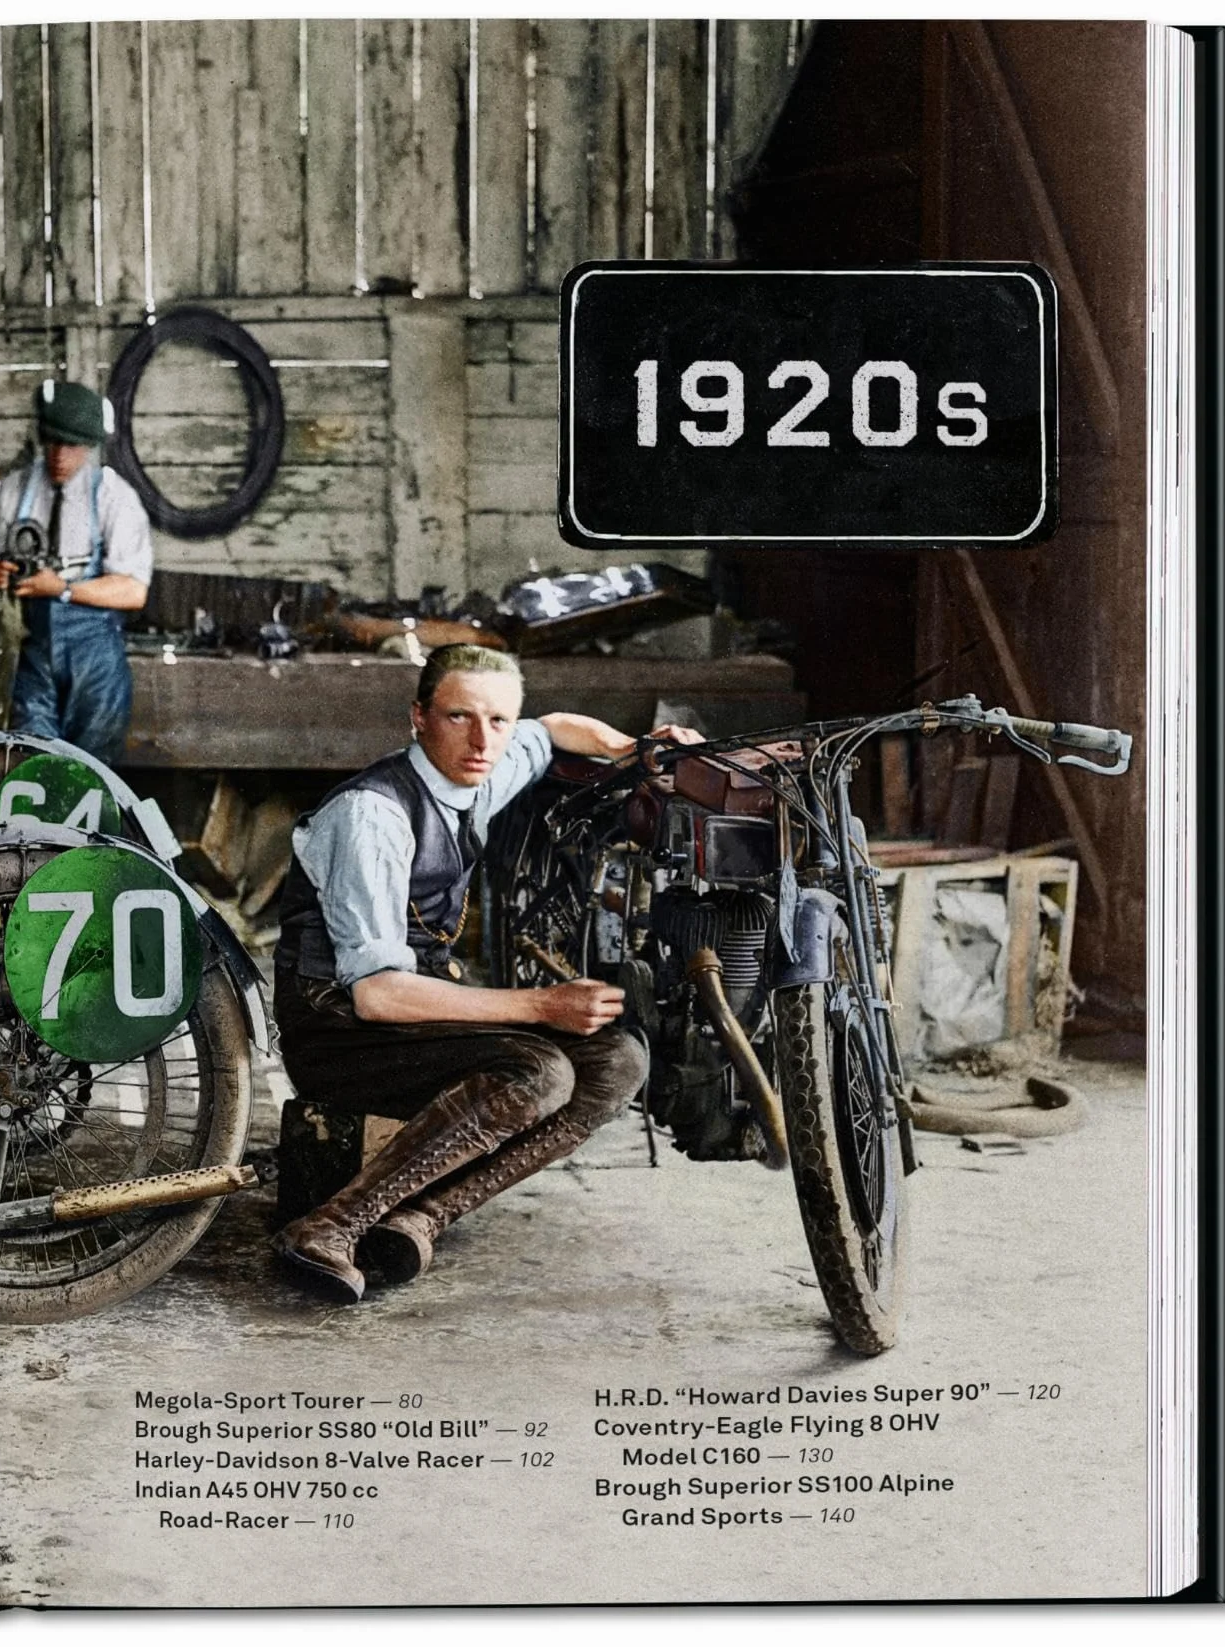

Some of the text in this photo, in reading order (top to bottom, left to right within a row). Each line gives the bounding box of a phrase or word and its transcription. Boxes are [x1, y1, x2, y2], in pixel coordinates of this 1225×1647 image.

[633, 359, 988, 447] 1920s
[27, 889, 183, 1020] 70
[135, 1391, 423, 1415] Megola-Sport Tourer 80
[595, 1387, 669, 1407] H.R.D.
[787, 1385, 868, 1404] Davies
[873, 1384, 945, 1407] Super
[1028, 1384, 1061, 1400] 120
[135, 1420, 211, 1444] Brough
[216, 1421, 314, 1444] Superior
[318, 1421, 377, 1439] SS80
[524, 1422, 548, 1438] 92
[594, 1413, 940, 1440] Coventry-Eagle Flying 8 OHV
[135, 1450, 555, 1474] Harley-Davidson 8-Valve Racer 102
[622, 1447, 834, 1466] Model C160 130
[135, 1480, 379, 1499] Indian A45 OHV 750 cc
[595, 1473, 955, 1501] Brough Superior SS100 Alpine
[159, 1510, 355, 1529] Road-Racer 110
[622, 1507, 855, 1530] Grand Sports 140
